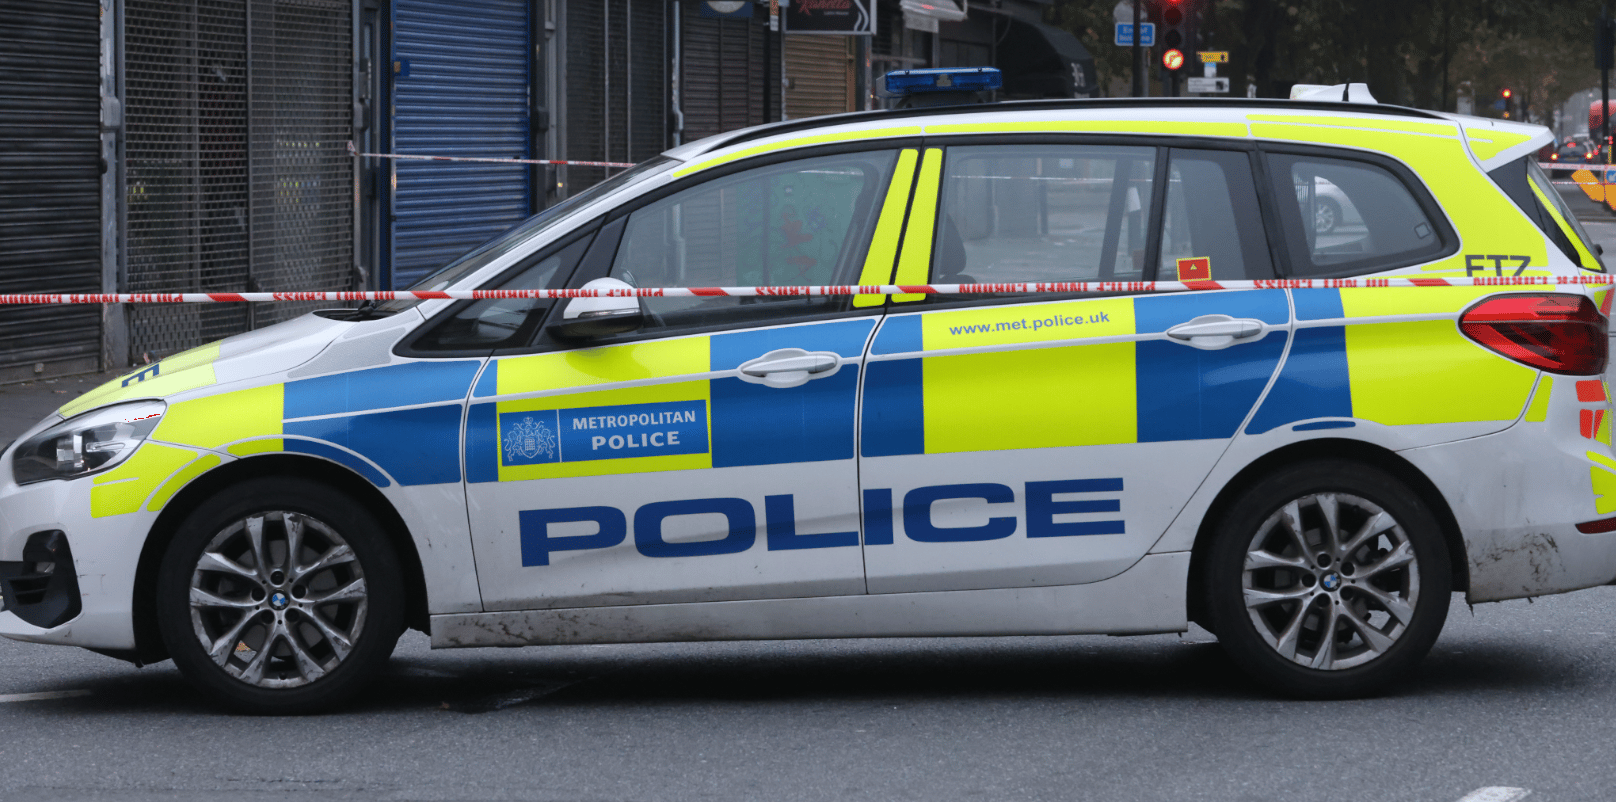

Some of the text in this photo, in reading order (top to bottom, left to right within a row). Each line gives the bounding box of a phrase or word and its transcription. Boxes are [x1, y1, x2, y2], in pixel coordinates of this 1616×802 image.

[948, 311, 1110, 336] www.met.police.uk
[572, 410, 696, 430] METROPOLITAN
[591, 431, 681, 450] POLICE
[518, 477, 1126, 567] POLICE
